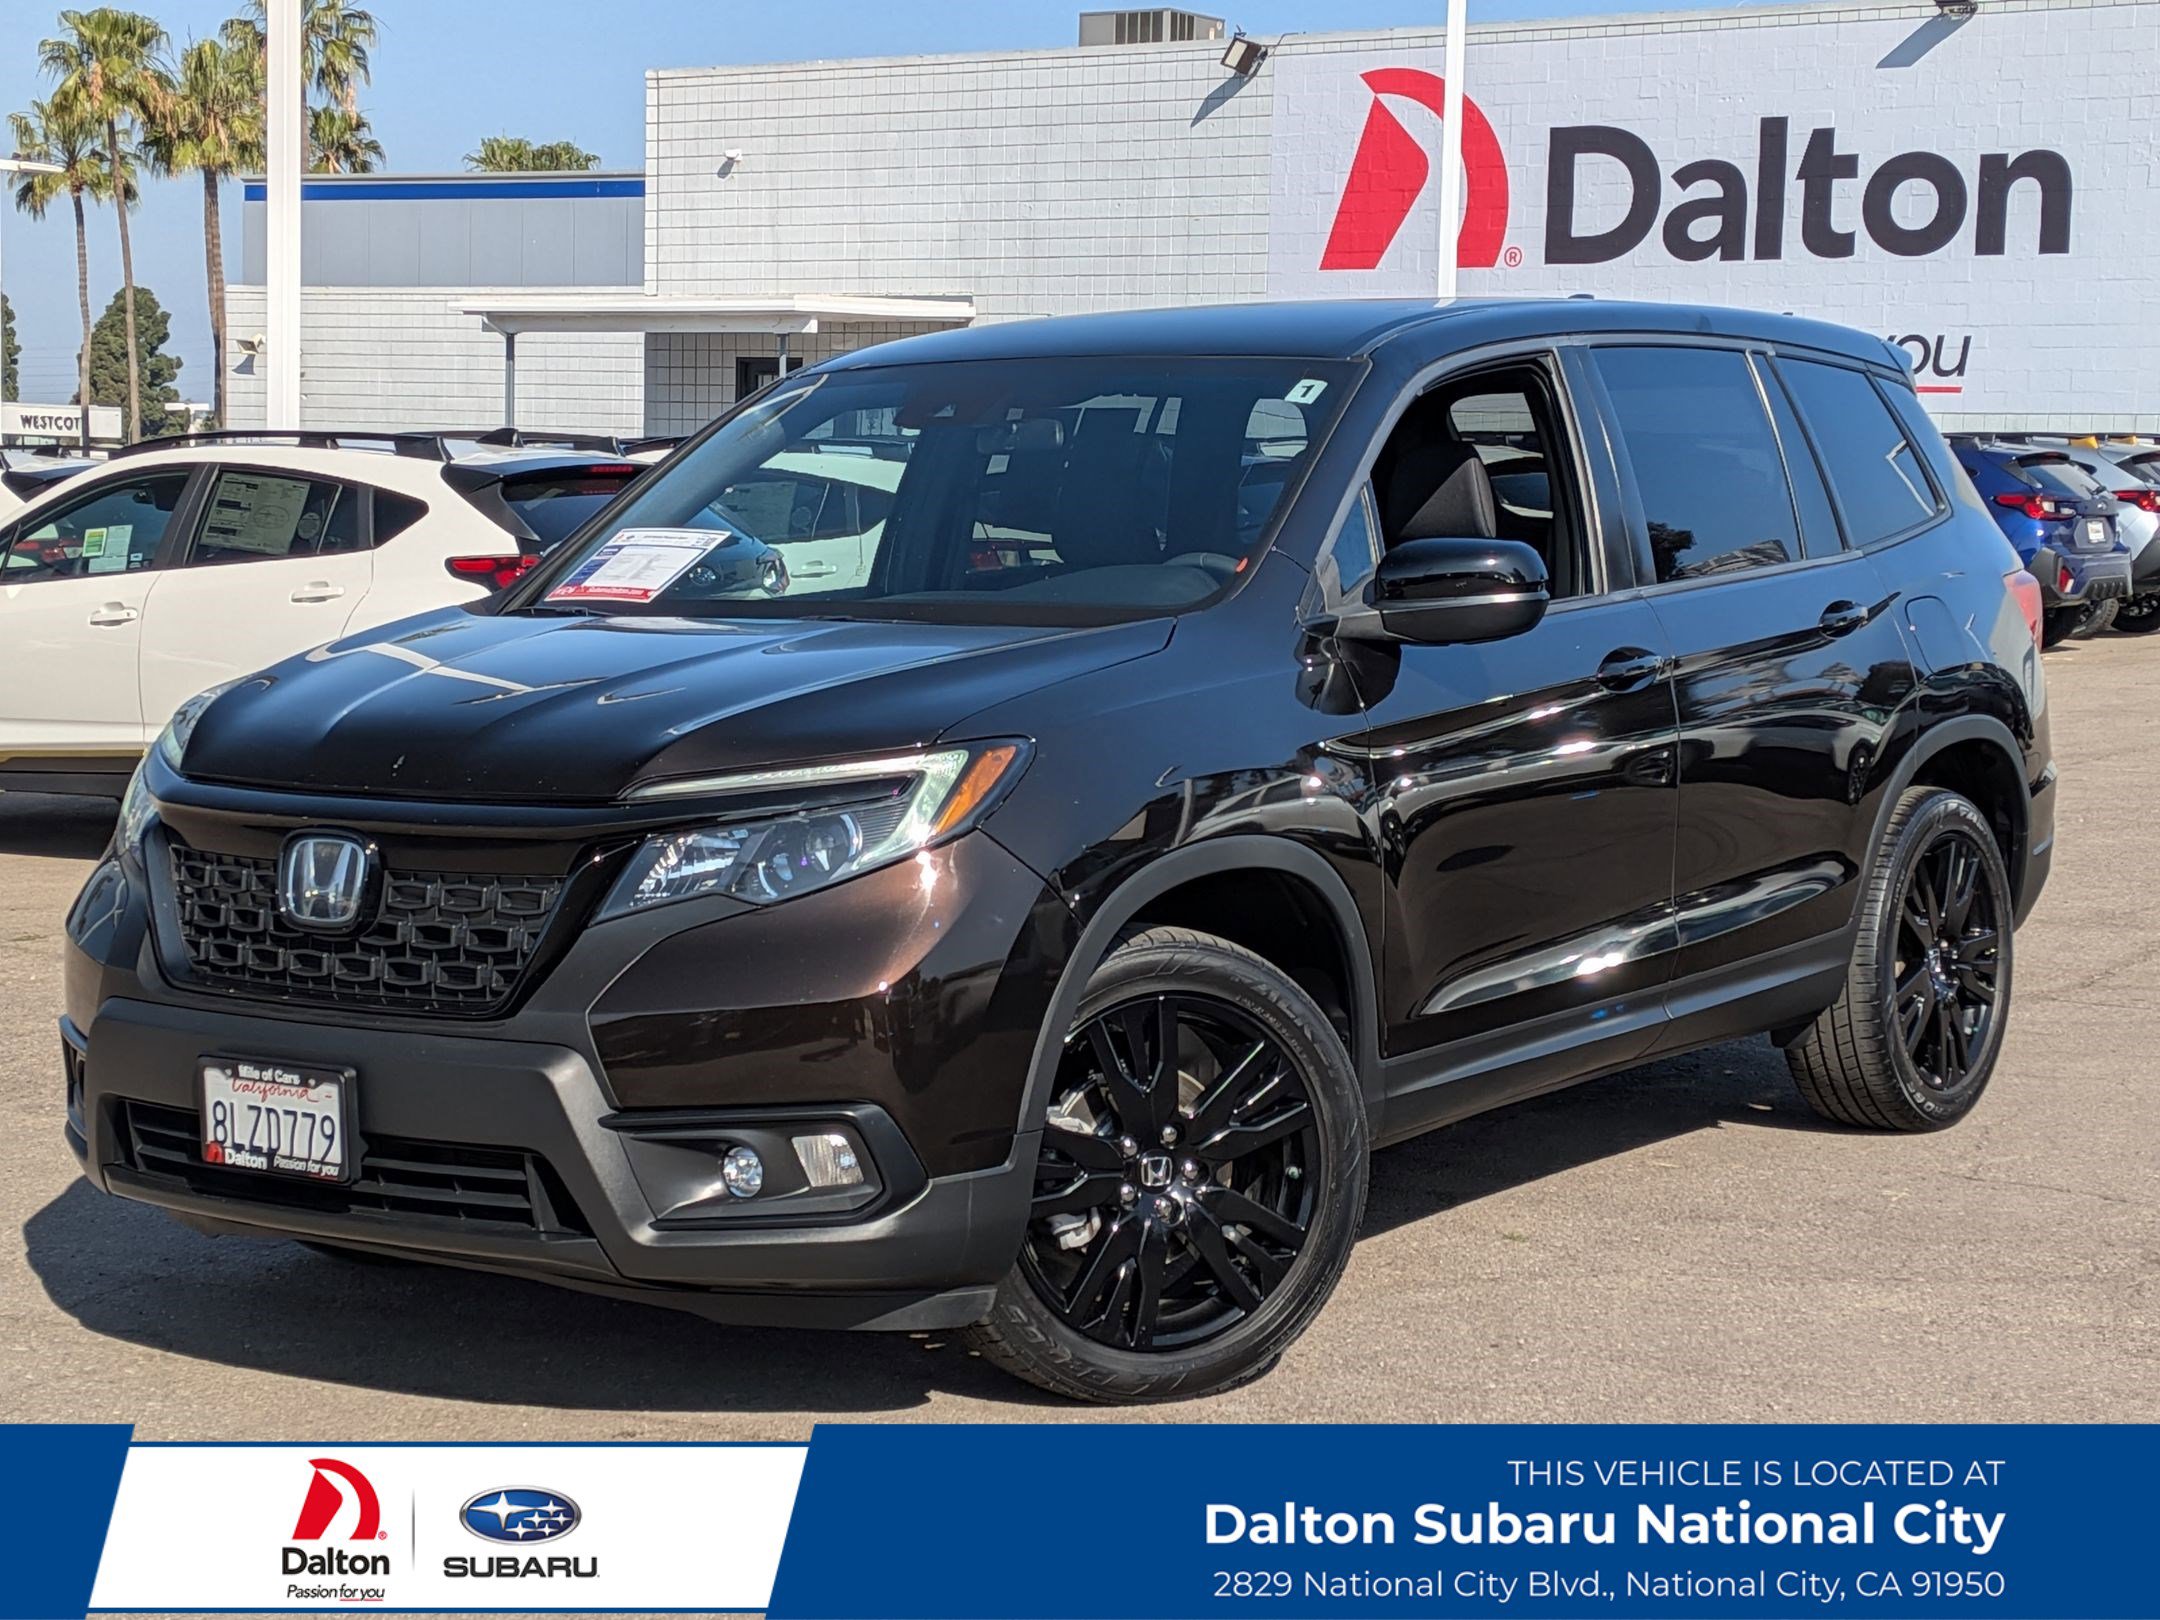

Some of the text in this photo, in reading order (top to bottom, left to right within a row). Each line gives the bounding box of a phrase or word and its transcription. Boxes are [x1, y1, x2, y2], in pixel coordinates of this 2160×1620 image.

[1545, 117, 2073, 264] Dalton
[1887, 333, 1972, 377] ou
[1301, 384, 1315, 398] 1
[261, 1068, 272, 1080] of
[275, 1070, 300, 1084] Cars
[232, 1077, 319, 1103] California
[213, 1100, 335, 1162] 8LZD779
[224, 1148, 267, 1169] Dalton
[274, 1155, 339, 1176] Passion for you
